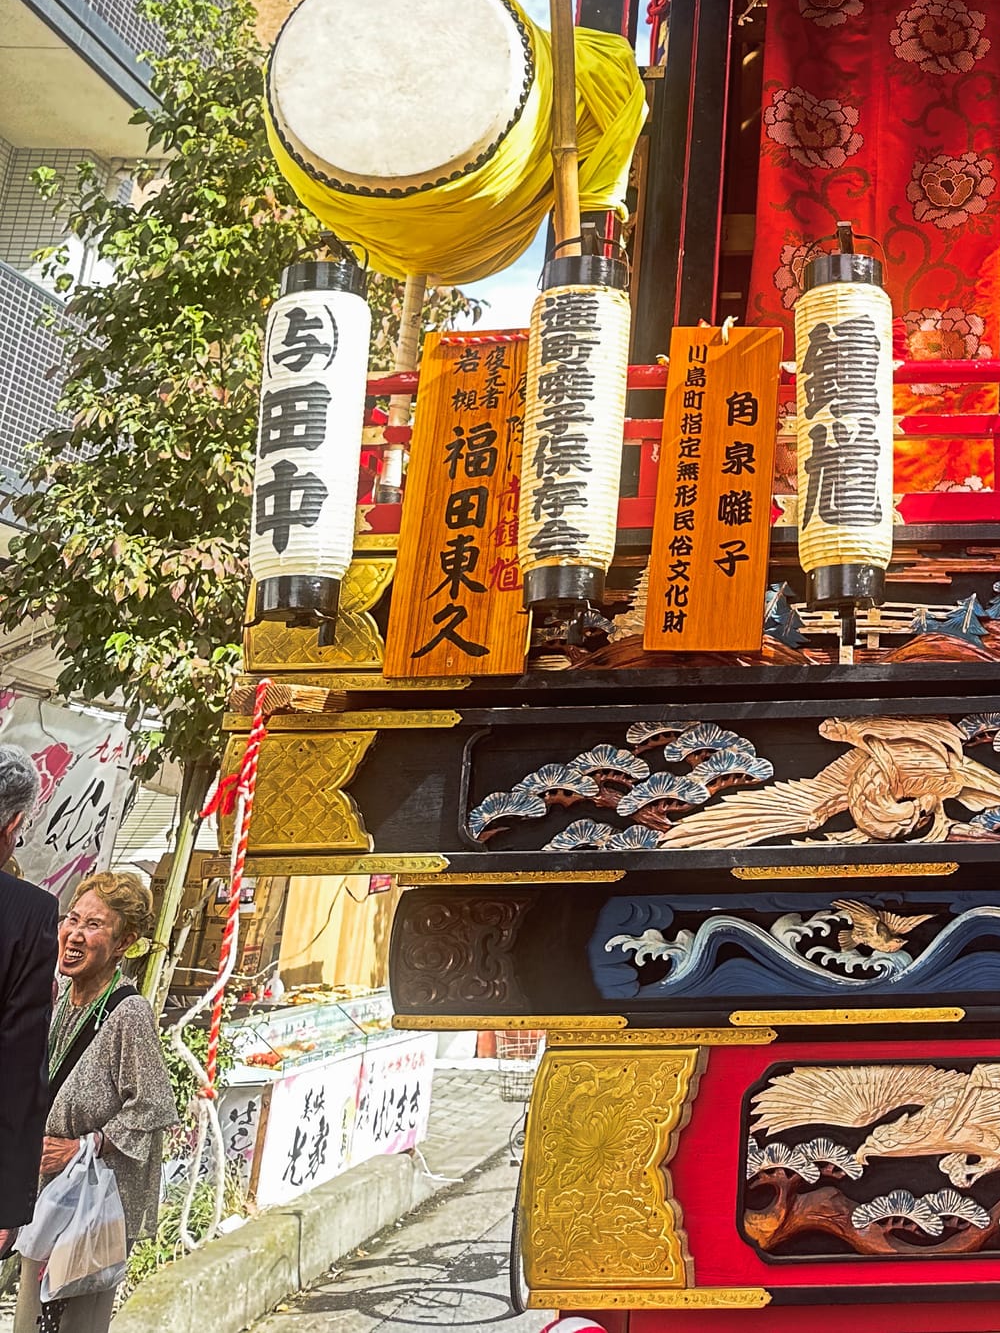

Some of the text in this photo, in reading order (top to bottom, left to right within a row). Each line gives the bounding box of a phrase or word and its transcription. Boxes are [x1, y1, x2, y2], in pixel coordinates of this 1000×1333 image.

[410, 422, 499, 659] 福田東久
[661, 343, 709, 634] 川島町指定無形民俗文化財
[714, 391, 759, 578] 角泉囃子
